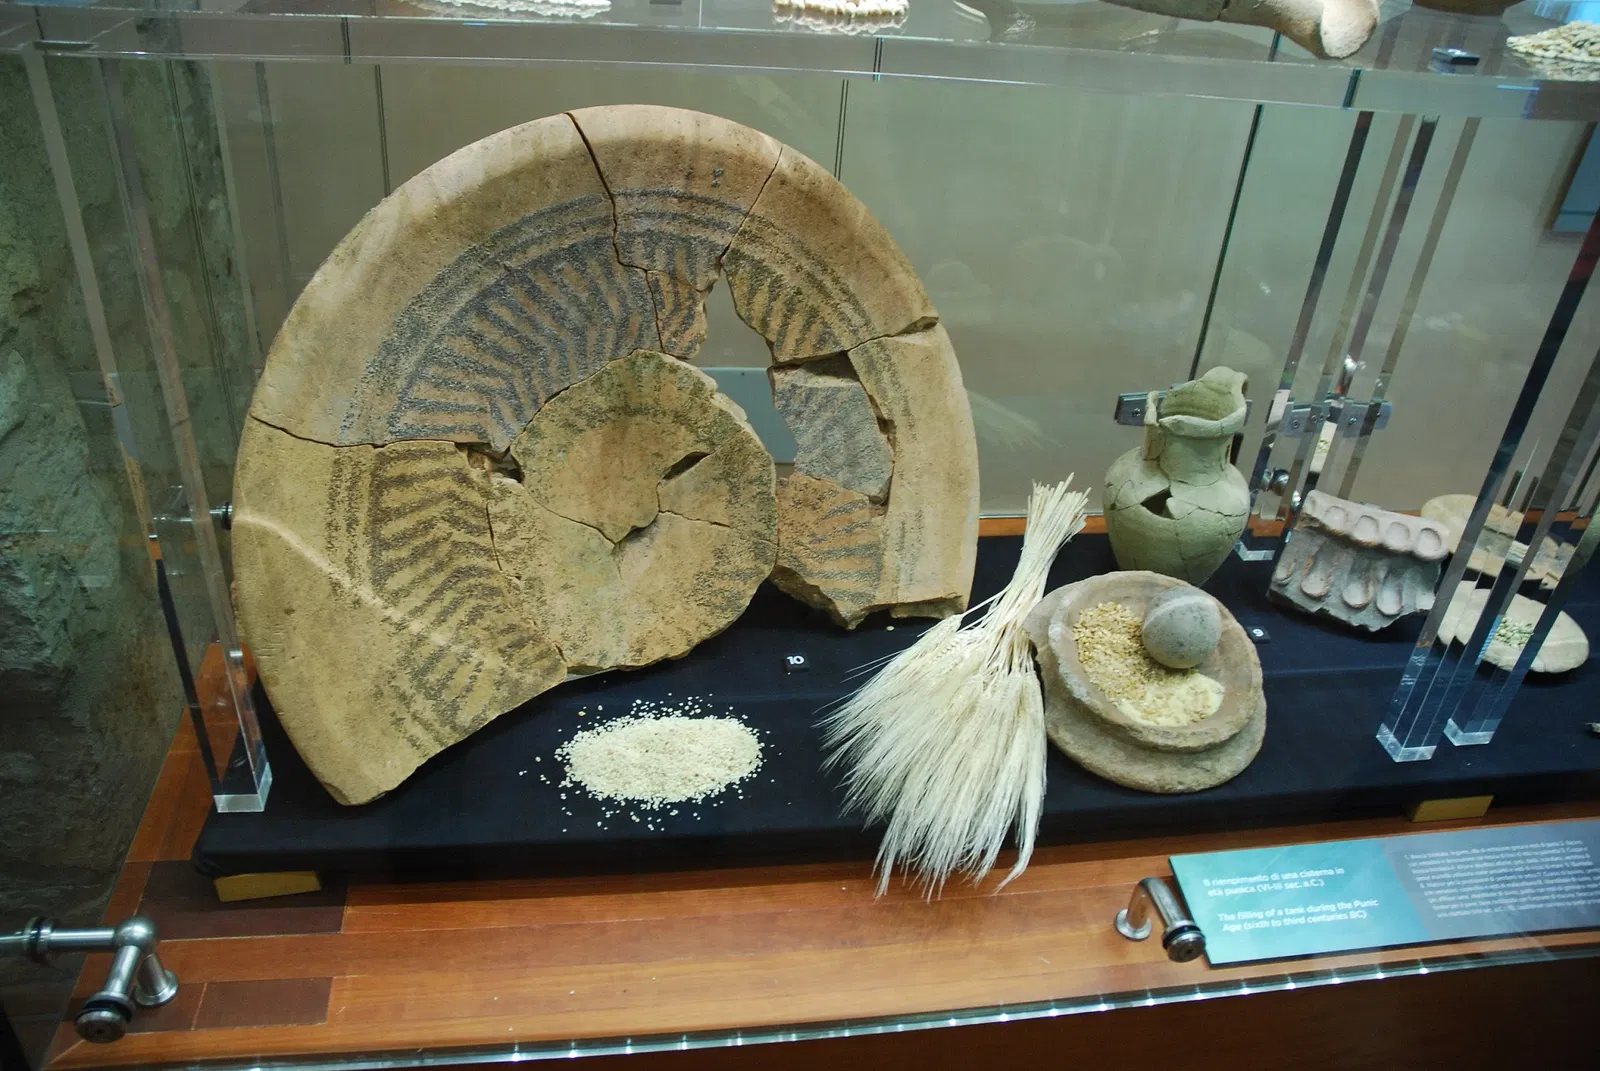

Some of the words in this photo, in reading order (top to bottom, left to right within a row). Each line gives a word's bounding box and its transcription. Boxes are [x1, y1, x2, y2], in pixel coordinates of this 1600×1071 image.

[786, 655, 805, 665] 10
[1211, 874, 1269, 887] riempimento
[1270, 872, 1280, 880] di
[1281, 872, 1298, 880] una
[1299, 869, 1334, 878] cisterna
[1335, 867, 1345, 875] in
[1224, 886, 1256, 897] punica
[1284, 881, 1302, 890] sec.
[1218, 913, 1235, 921] The
[1237, 911, 1264, 920] filling
[1264, 909, 1276, 918] of
[1285, 907, 1305, 915] tank
[1306, 904, 1337, 914] during
[1337, 901, 1353, 910] the
[1353, 899, 1380, 908] Punic
[1223, 922, 1241, 933] Age
[1243, 919, 1270, 930] (sixth
[1271, 918, 1282, 927] to
[1283, 916, 1305, 925] third
[1307, 912, 1348, 924] centuries
[1349, 910, 1368, 920] BC)
